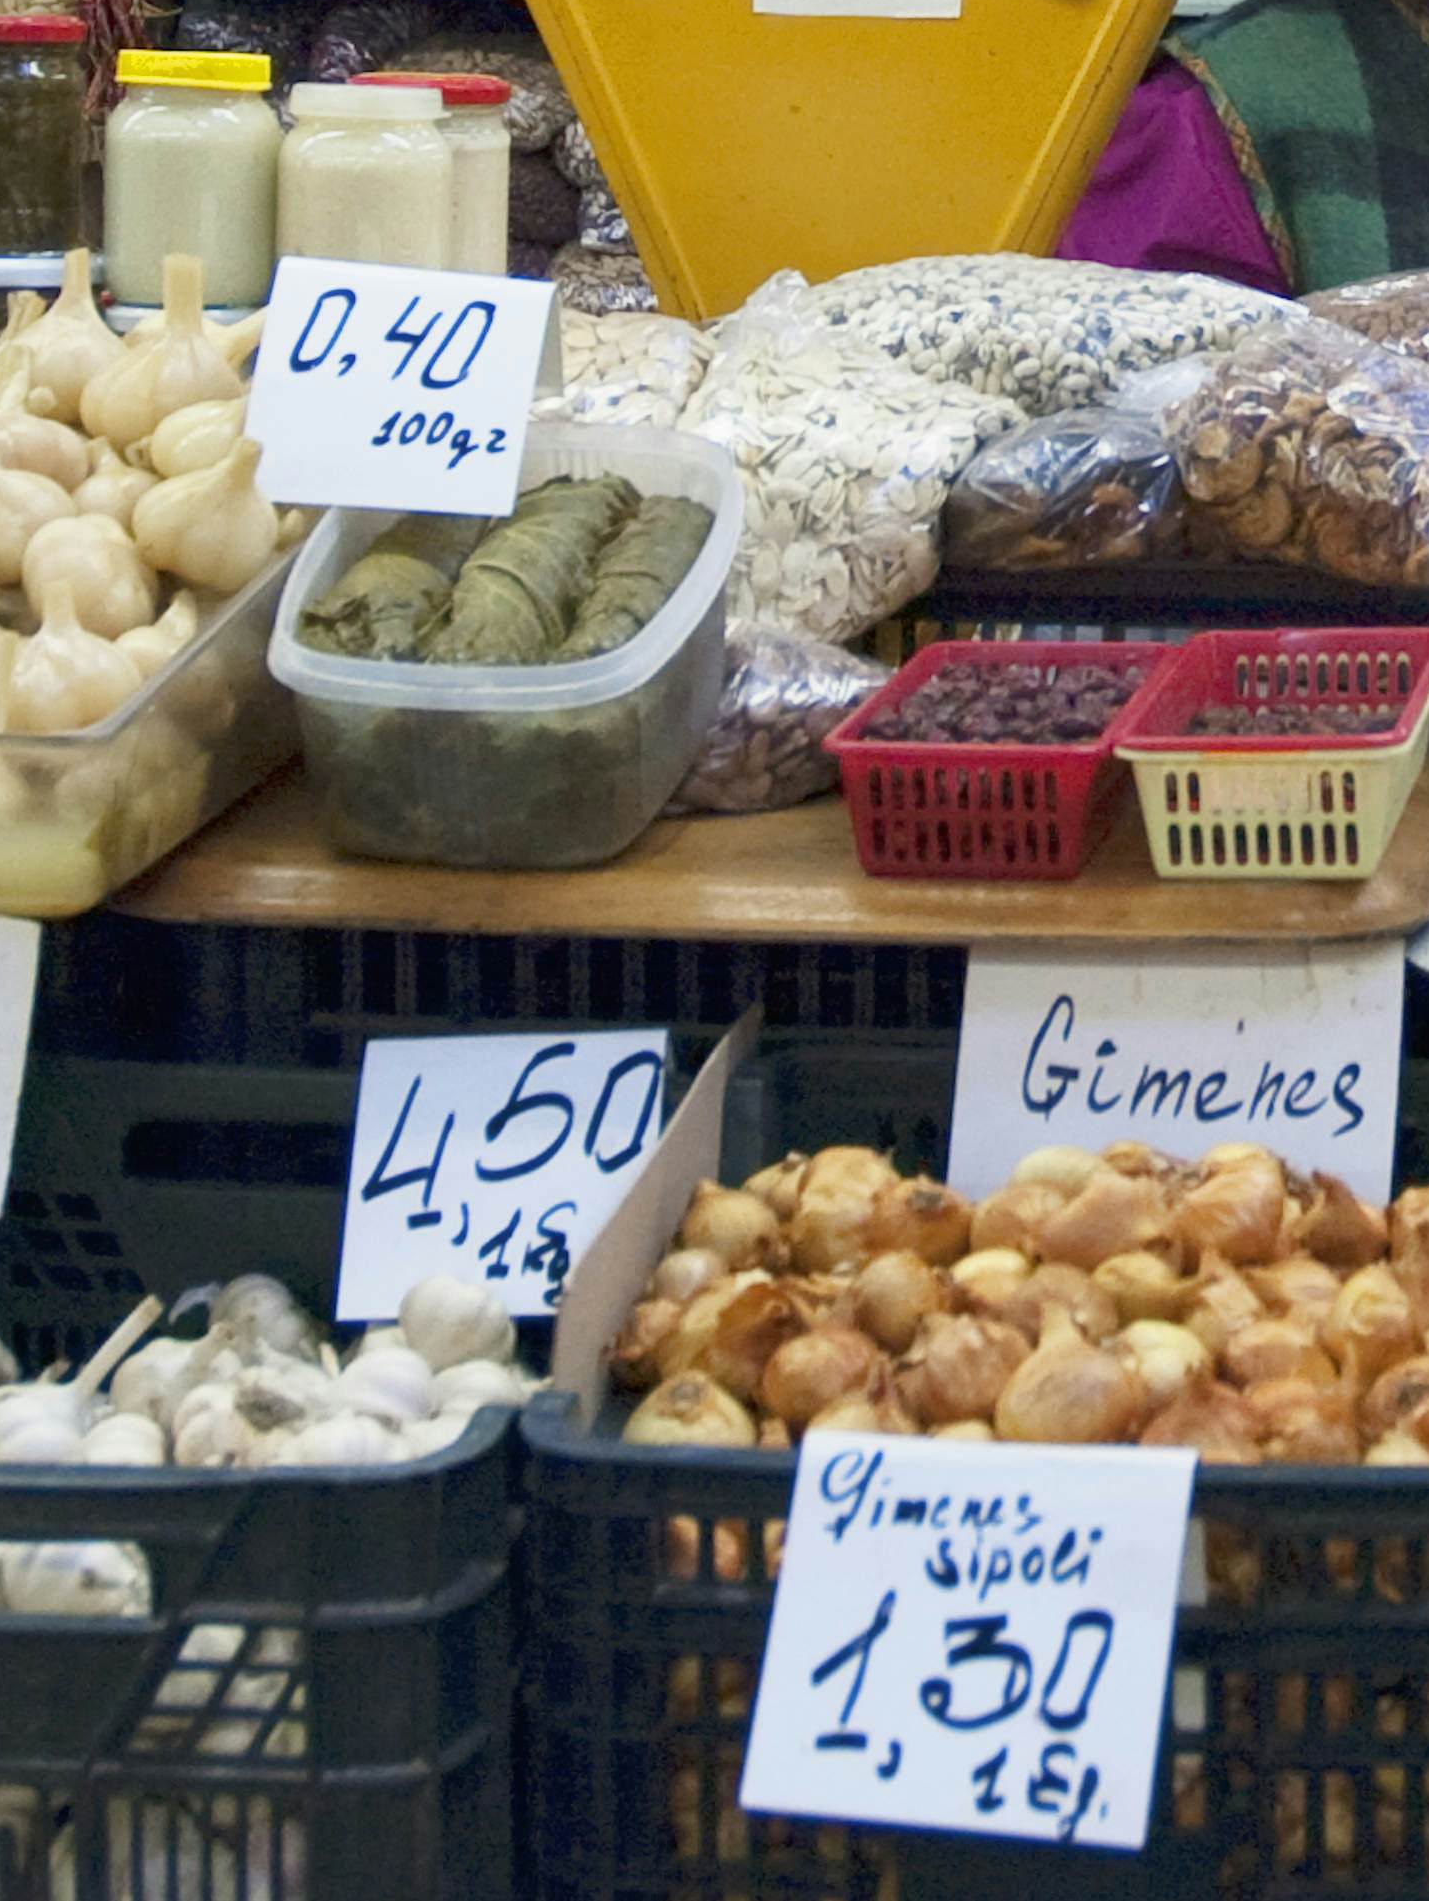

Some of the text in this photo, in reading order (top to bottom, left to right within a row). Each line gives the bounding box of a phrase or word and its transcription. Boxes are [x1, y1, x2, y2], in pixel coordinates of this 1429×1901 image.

[288, 288, 497, 391] 0,40
[361, 1040, 663, 1246] 4,50
[811, 1588, 1116, 1780] 1,30
